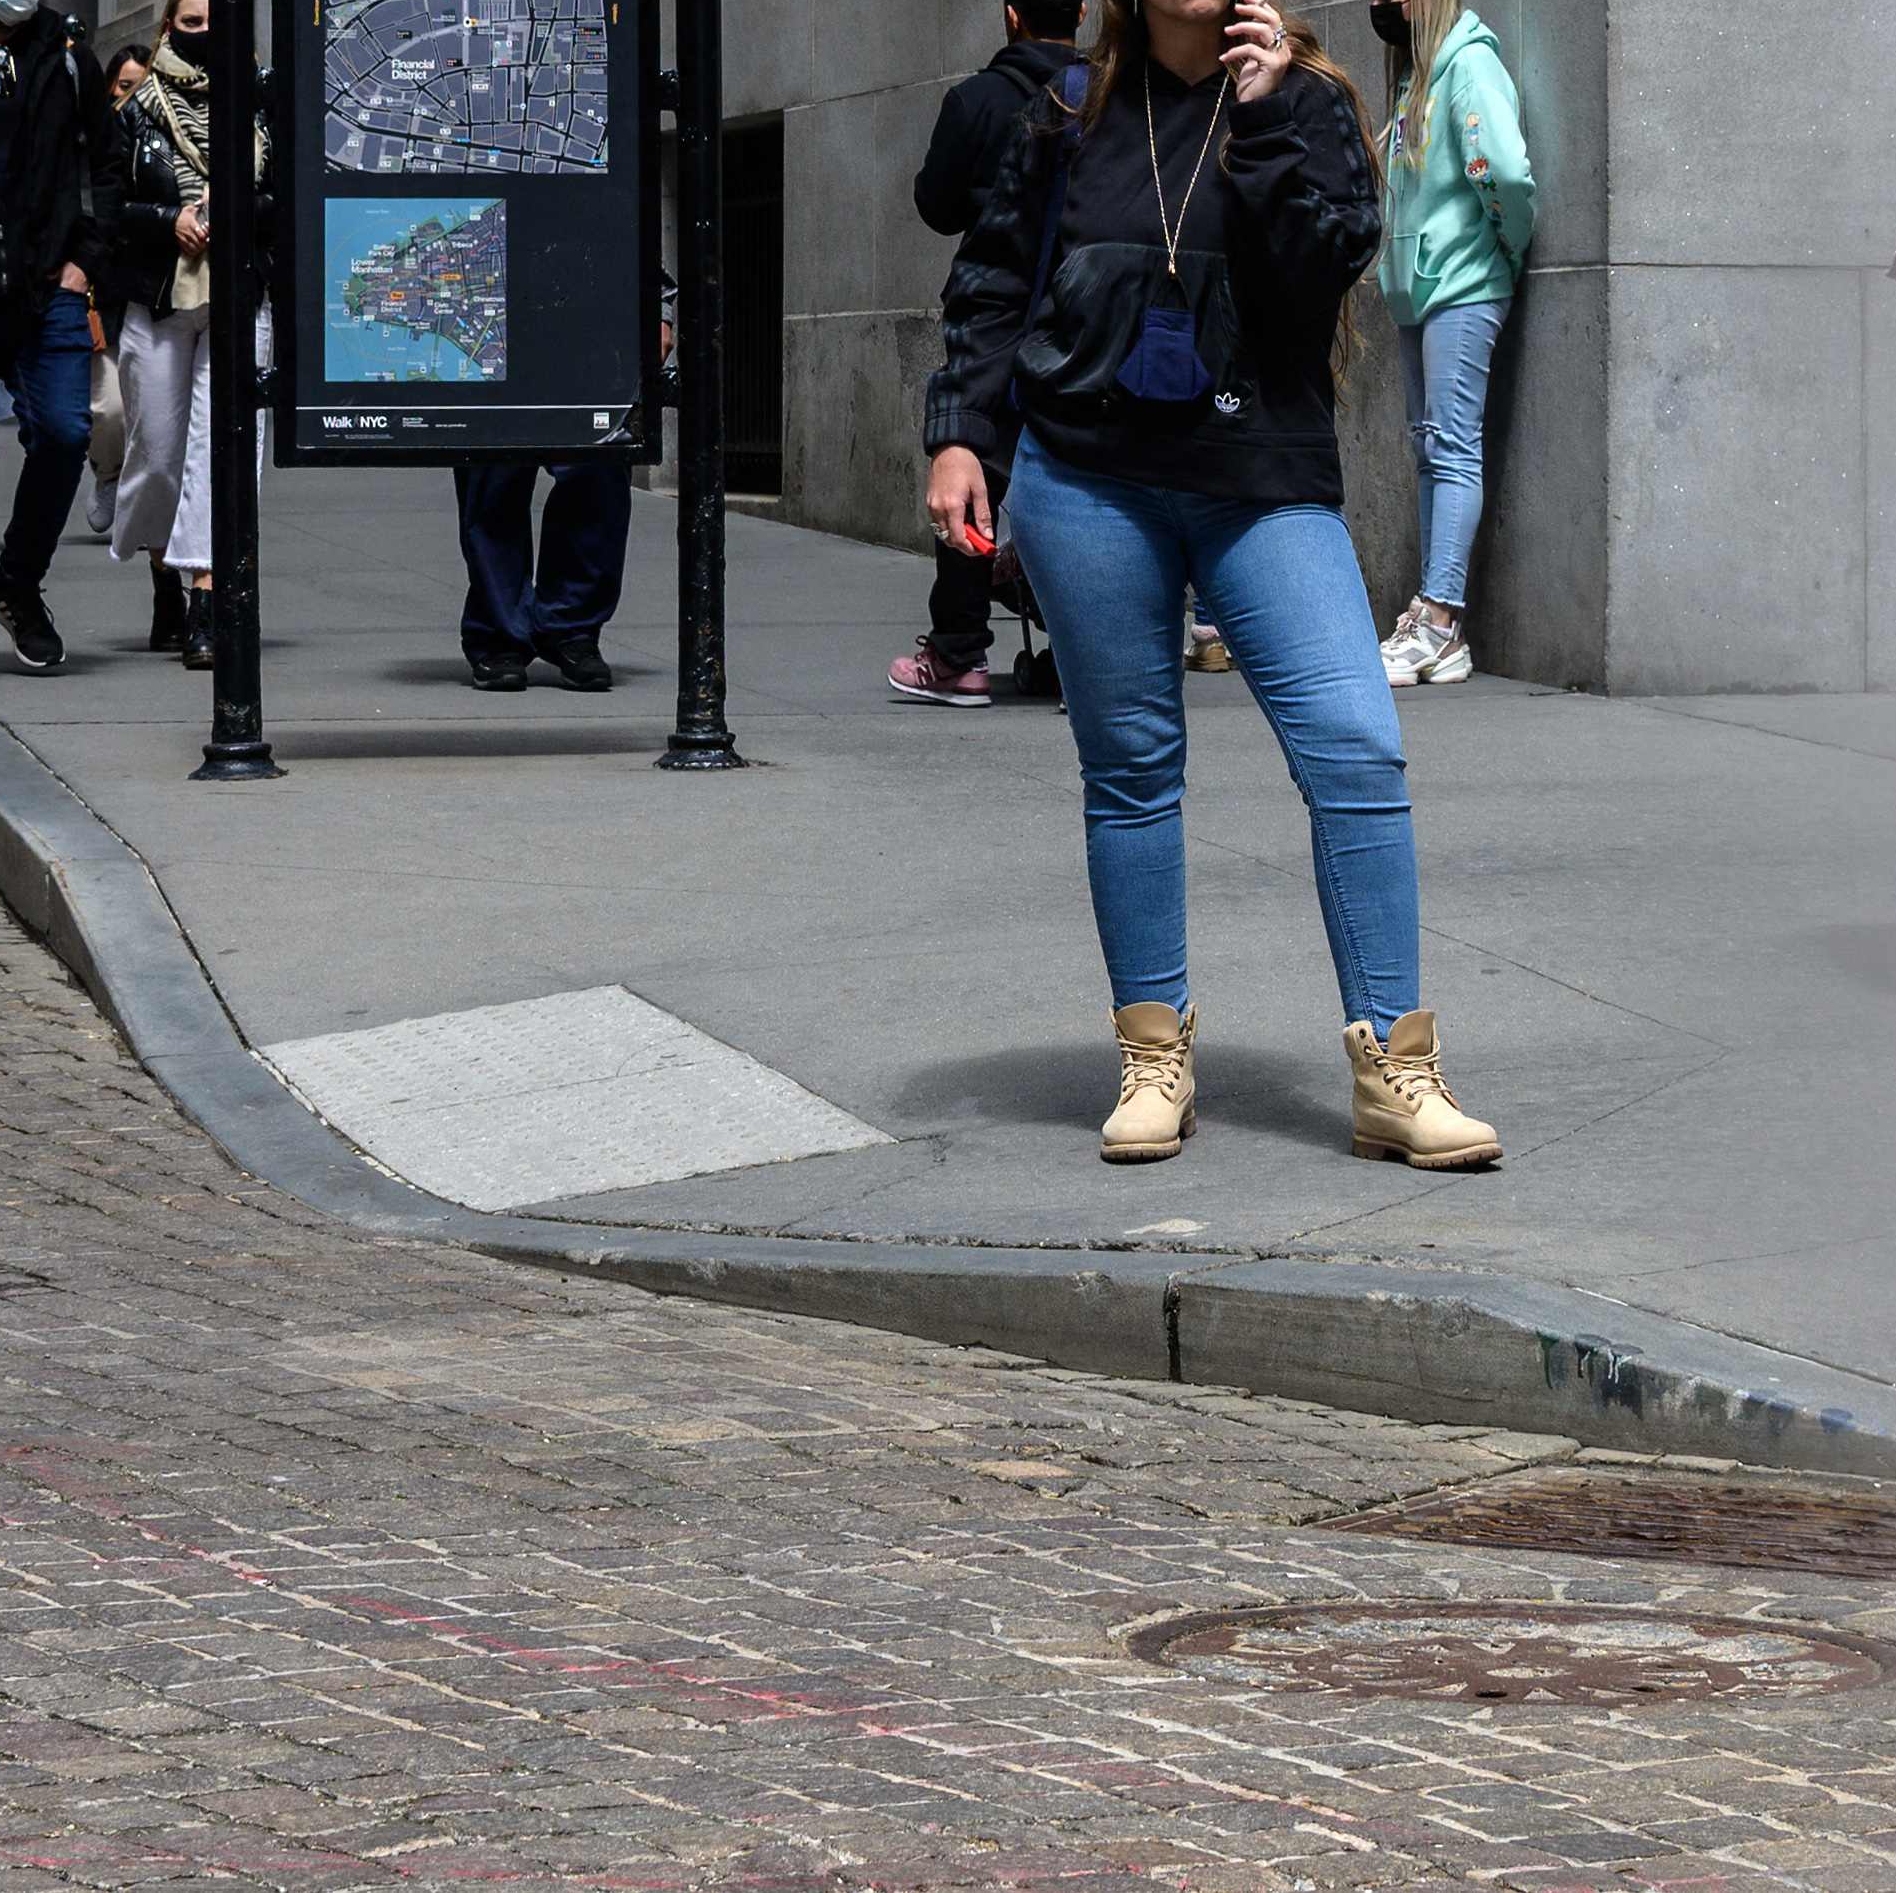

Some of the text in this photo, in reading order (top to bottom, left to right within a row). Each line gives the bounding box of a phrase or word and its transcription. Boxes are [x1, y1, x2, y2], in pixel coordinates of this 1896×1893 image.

[392, 60, 435, 69] Financial
[392, 70, 427, 80] District
[323, 416, 387, 428] Walk NYC
